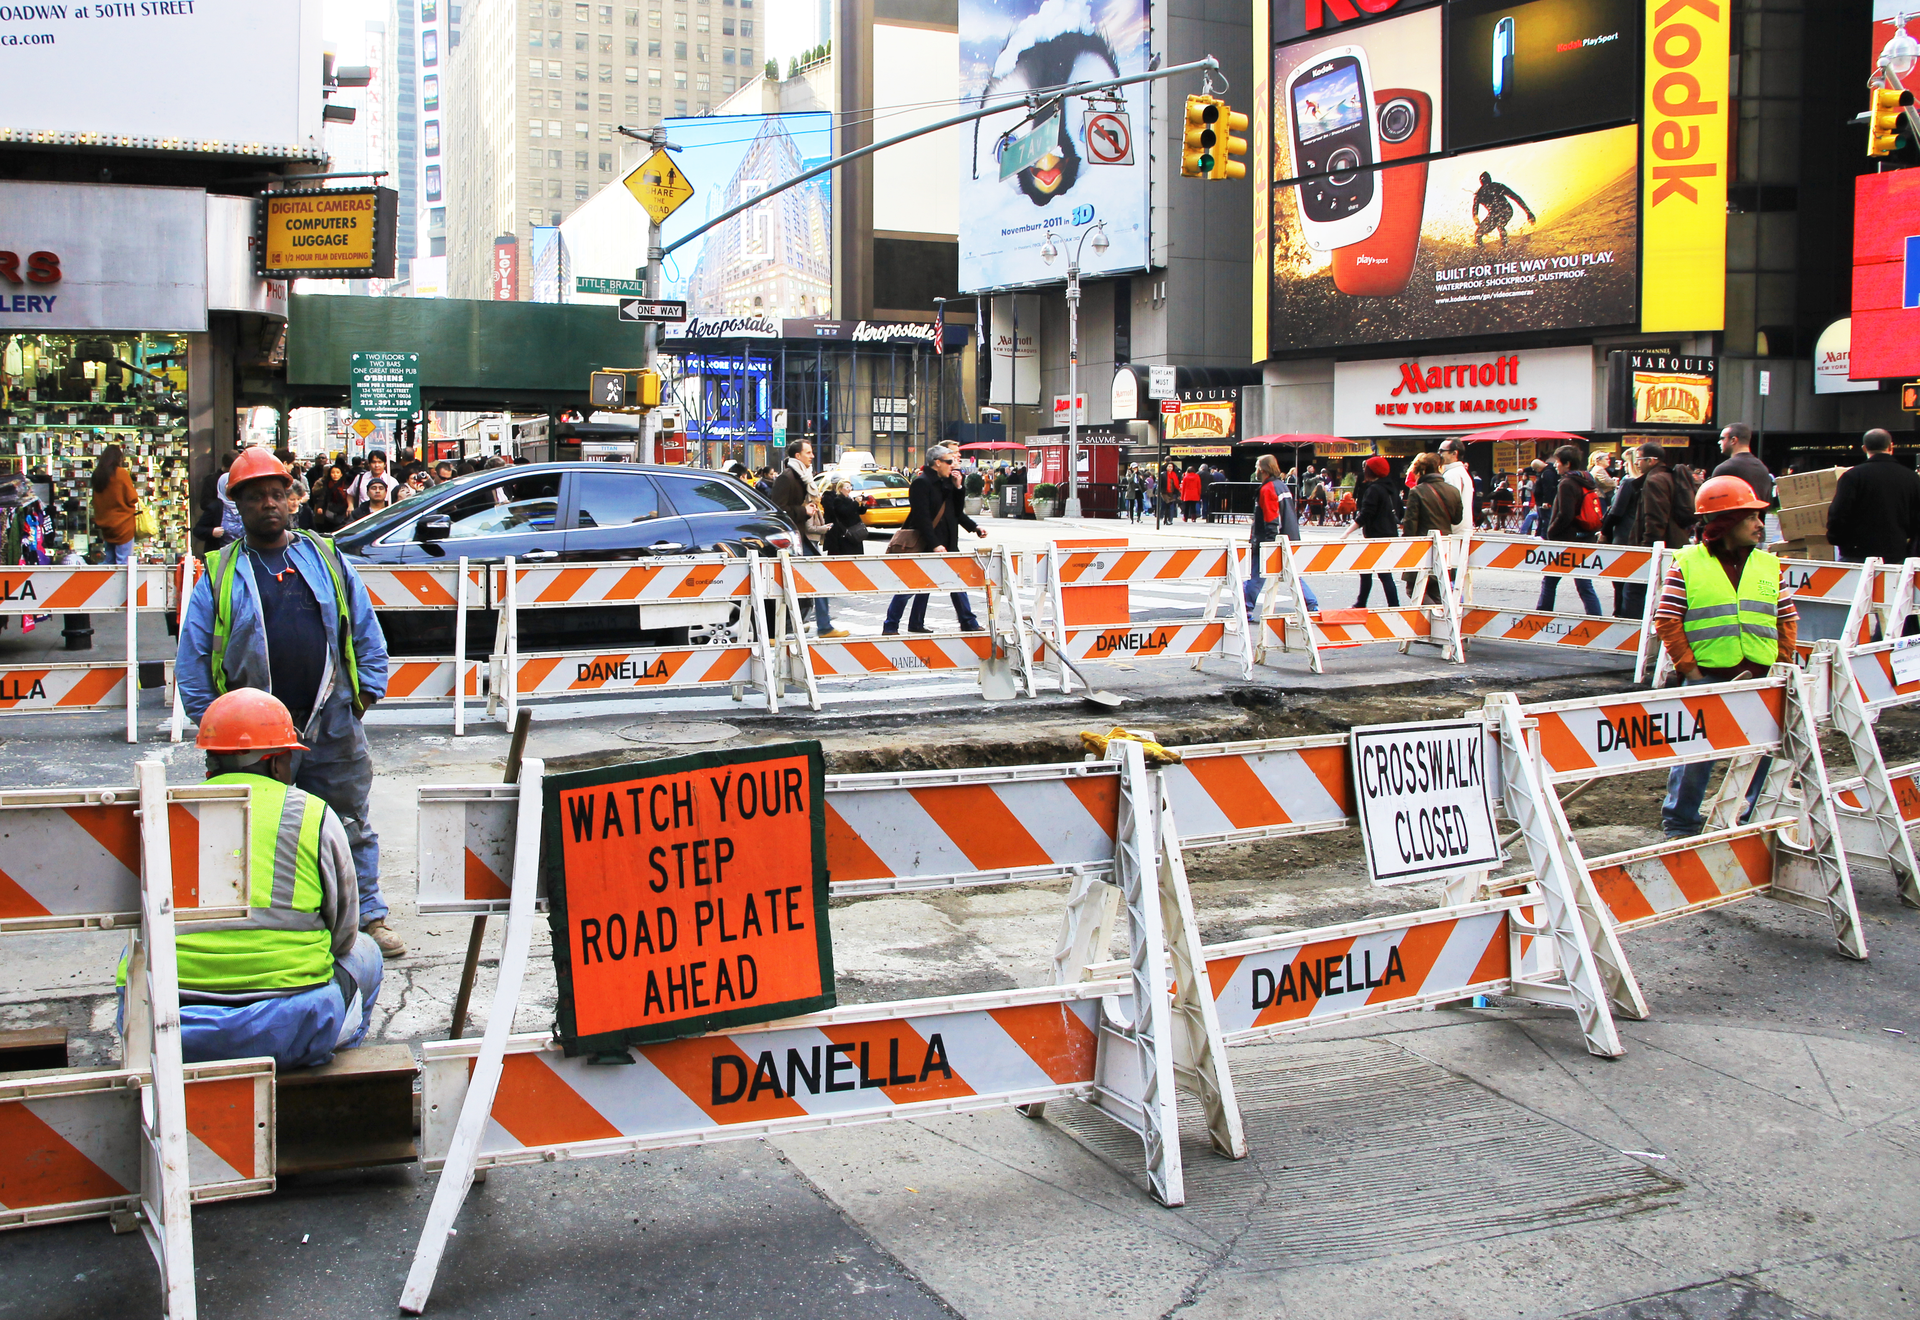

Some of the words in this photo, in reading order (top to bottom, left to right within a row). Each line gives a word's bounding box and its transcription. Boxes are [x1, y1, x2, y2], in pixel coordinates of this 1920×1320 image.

[0, 5, 67, 21] OADWAY
[74, 6, 90, 18] at
[95, 2, 136, 18] 50TH
[141, 0, 194, 16] STREET
[0, 34, 55, 46] ca.com
[1312, 63, 1334, 78] Kodak
[1018, 144, 1026, 164] 7
[1254, 78, 1266, 264] Kodak
[646, 186, 674, 198] SHARE
[272, 202, 314, 214] DIGITAL
[316, 199, 372, 212] CAMERAS
[648, 204, 670, 214] ROAD
[286, 217, 357, 230] COMPUTERS
[1001, 222, 1042, 236] Novemburr
[1043, 216, 1062, 228] 2011
[1071, 203, 1094, 226] 3D
[292, 234, 348, 247] LUGGAGE
[330, 252, 368, 260] DEVELOPING
[0, 250, 62, 284] RS
[1435, 268, 1466, 282] BUILT
[1469, 265, 1492, 277] FOR
[1494, 262, 1517, 275] THE
[1520, 258, 1548, 272] WAY
[1550, 255, 1578, 269] YOU
[1582, 251, 1614, 265] PLAY.
[576, 278, 606, 288] LITTLE
[610, 280, 642, 291] BRAZIL
[1435, 280, 1484, 292] WATERPROOF.
[1486, 274, 1537, 286] SHOCKPROOF.
[1538, 269, 1587, 282] DUSTPROOF.
[0, 295, 57, 313] LERY
[1435, 289, 1534, 304] www.kodak.com/go/videocameras
[637, 306, 655, 315] ONE
[660, 306, 680, 316] WAY
[686, 316, 778, 338] Aéropostale
[852, 320, 936, 343] Aéropostale
[998, 335, 1032, 346] Mariott
[1632, 356, 1714, 372] MARQUIS
[1390, 355, 1520, 397] Marriott
[1175, 389, 1236, 400] ARQUIS
[1644, 386, 1700, 422] FOLLIES
[1375, 403, 1408, 416] NEW
[1412, 400, 1455, 414] YORK
[1460, 398, 1538, 413] MARQUIS
[1173, 412, 1223, 438] FOLLIES
[1525, 550, 1603, 570] DANELLA
[1786, 570, 1812, 589] LA
[0, 580, 38, 600] LA
[1511, 617, 1591, 638] DANELLA
[1096, 632, 1168, 651] DANELLA
[578, 660, 669, 682] DANELLA
[891, 656, 931, 668] DANELLA
[0, 679, 46, 699] LLA
[1598, 708, 1707, 753] DANELLA
[1363, 737, 1480, 799] CROSSWALK
[568, 781, 694, 843] WATCH
[712, 767, 804, 822] YOUR
[1395, 805, 1468, 864] CLOSED
[648, 837, 734, 894] STEP
[580, 905, 678, 966] ROAD
[696, 886, 804, 947] PLATE
[644, 954, 758, 1017] AHEAD
[1252, 945, 1406, 1010] DANELLA
[712, 1034, 953, 1106] DANELLA
